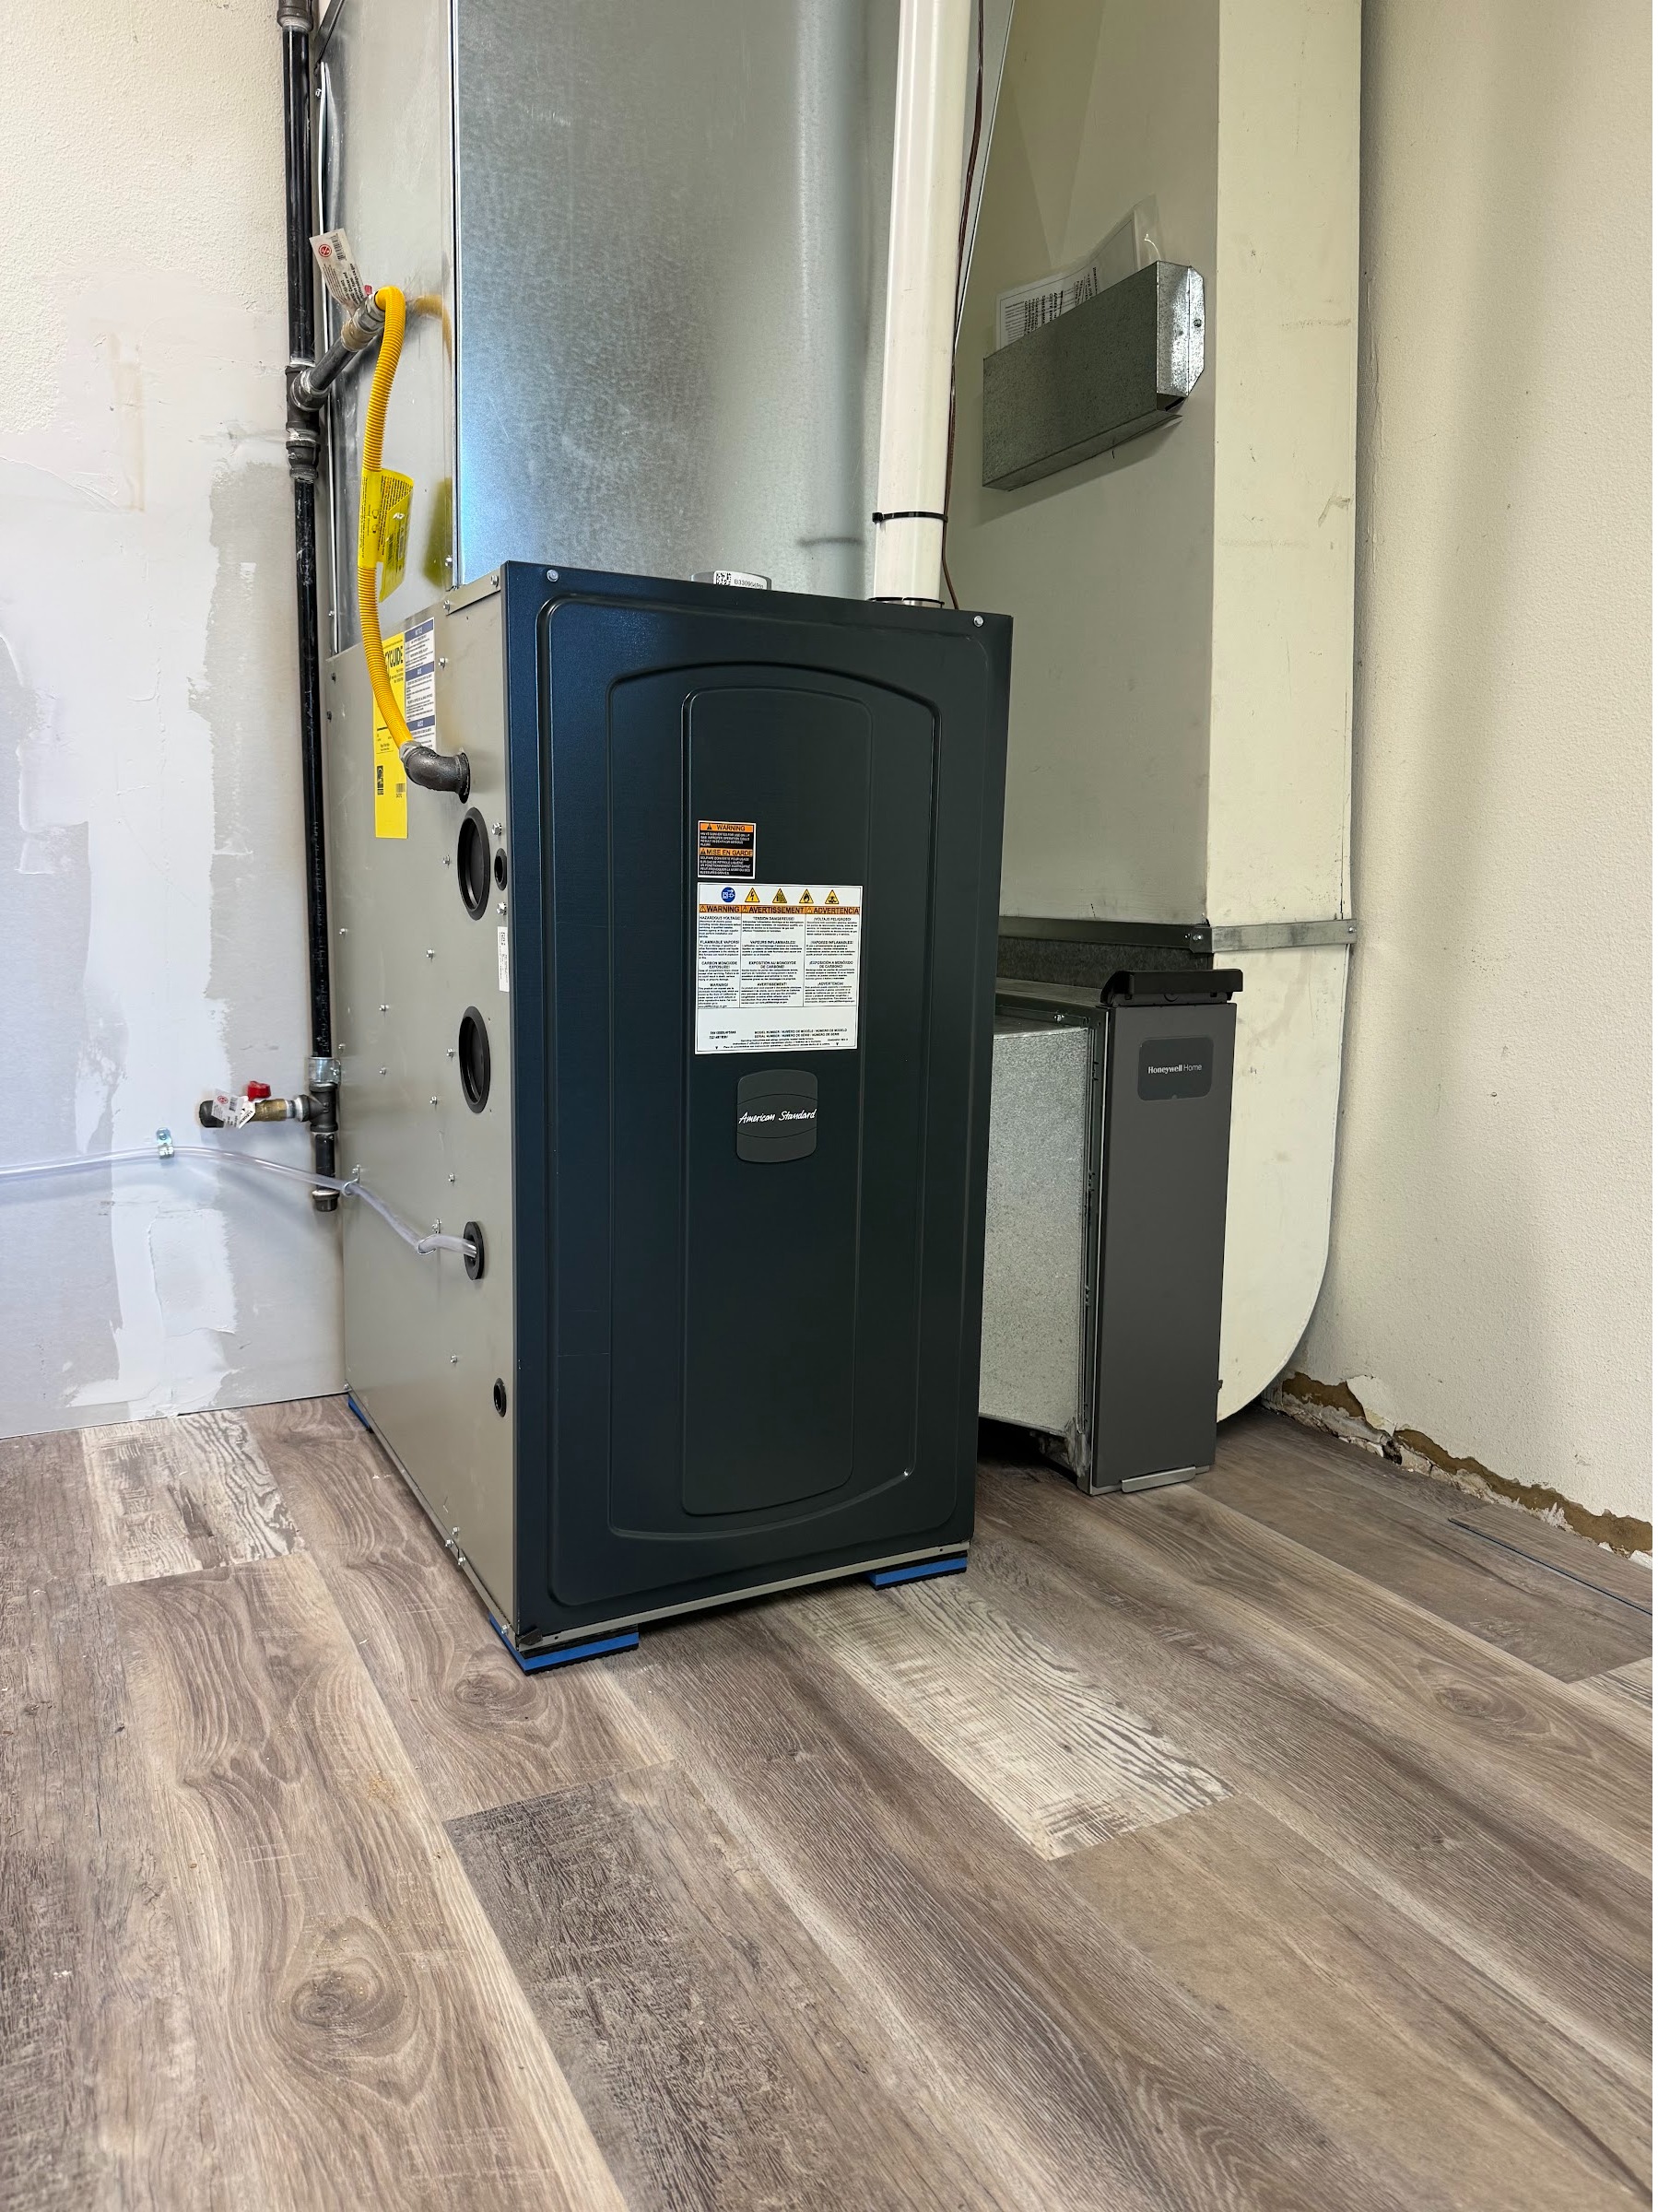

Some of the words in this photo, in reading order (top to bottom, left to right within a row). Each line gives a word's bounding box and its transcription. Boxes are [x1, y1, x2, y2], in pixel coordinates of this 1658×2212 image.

[748, 906, 804, 914] AVERTISSEMENT
[1147, 1064, 1182, 1075] Honeywell
[1183, 1064, 1203, 1072] Home
[738, 1111, 776, 1124] American
[778, 1108, 817, 1121] Standard
